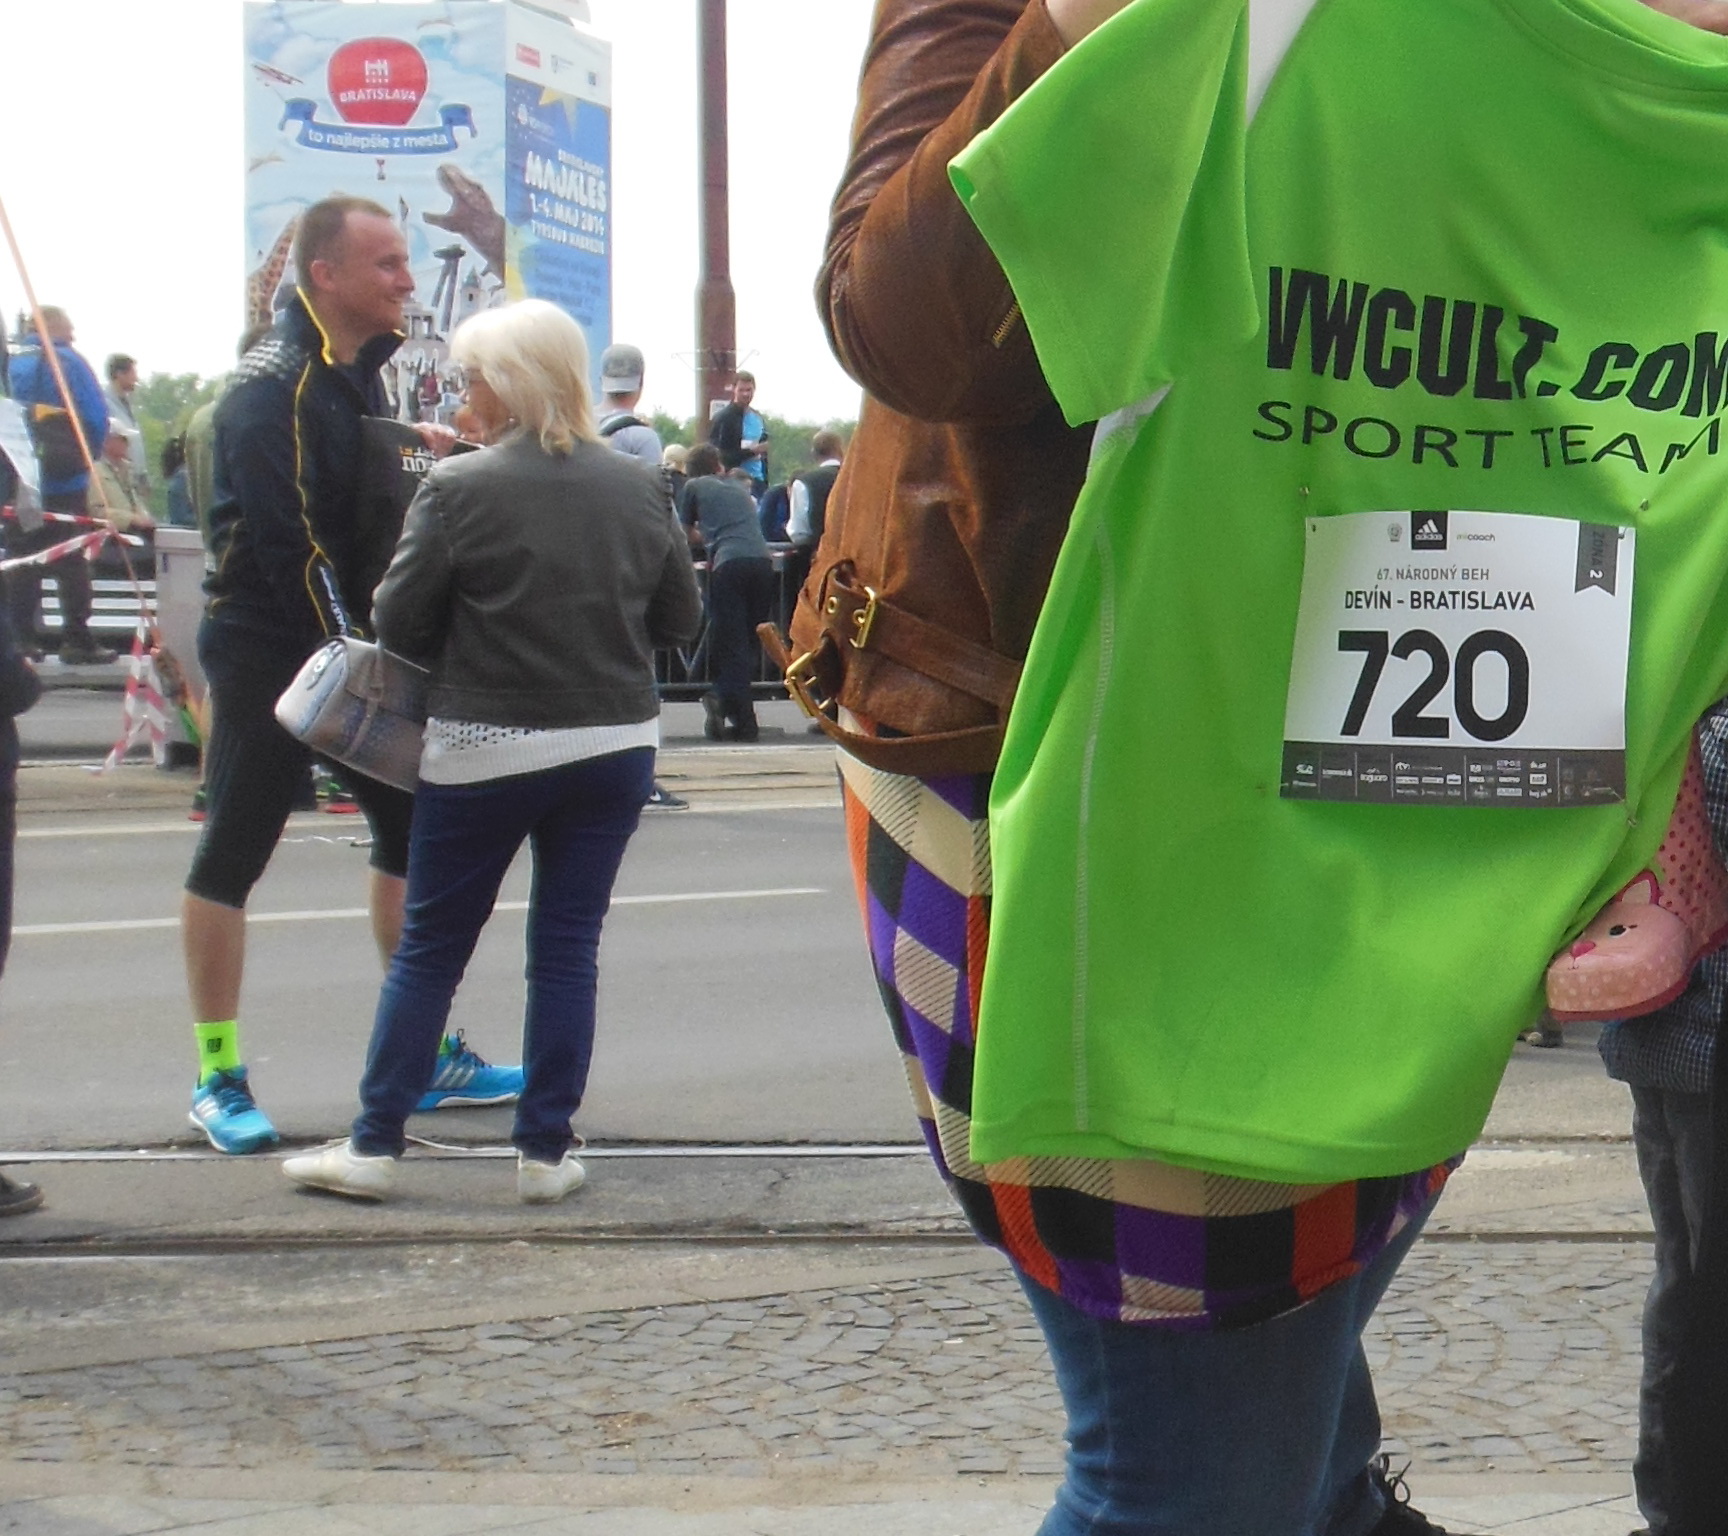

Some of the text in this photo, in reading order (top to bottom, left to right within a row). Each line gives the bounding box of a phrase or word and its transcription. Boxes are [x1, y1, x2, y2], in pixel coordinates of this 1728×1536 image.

[339, 88, 417, 103] BRATISLAVA
[308, 129, 322, 143] to
[393, 135, 401, 147] z
[403, 131, 449, 147] mesta
[1252, 400, 1721, 475] SPORT TEAM
[1376, 564, 1490, 581] 67. NÁRODNÝ BEH
[1589, 569, 1604, 580] 2
[1344, 584, 1392, 610] DEVÍN
[1409, 590, 1536, 611] BRATISLAVA
[1337, 628, 1530, 743] 720
